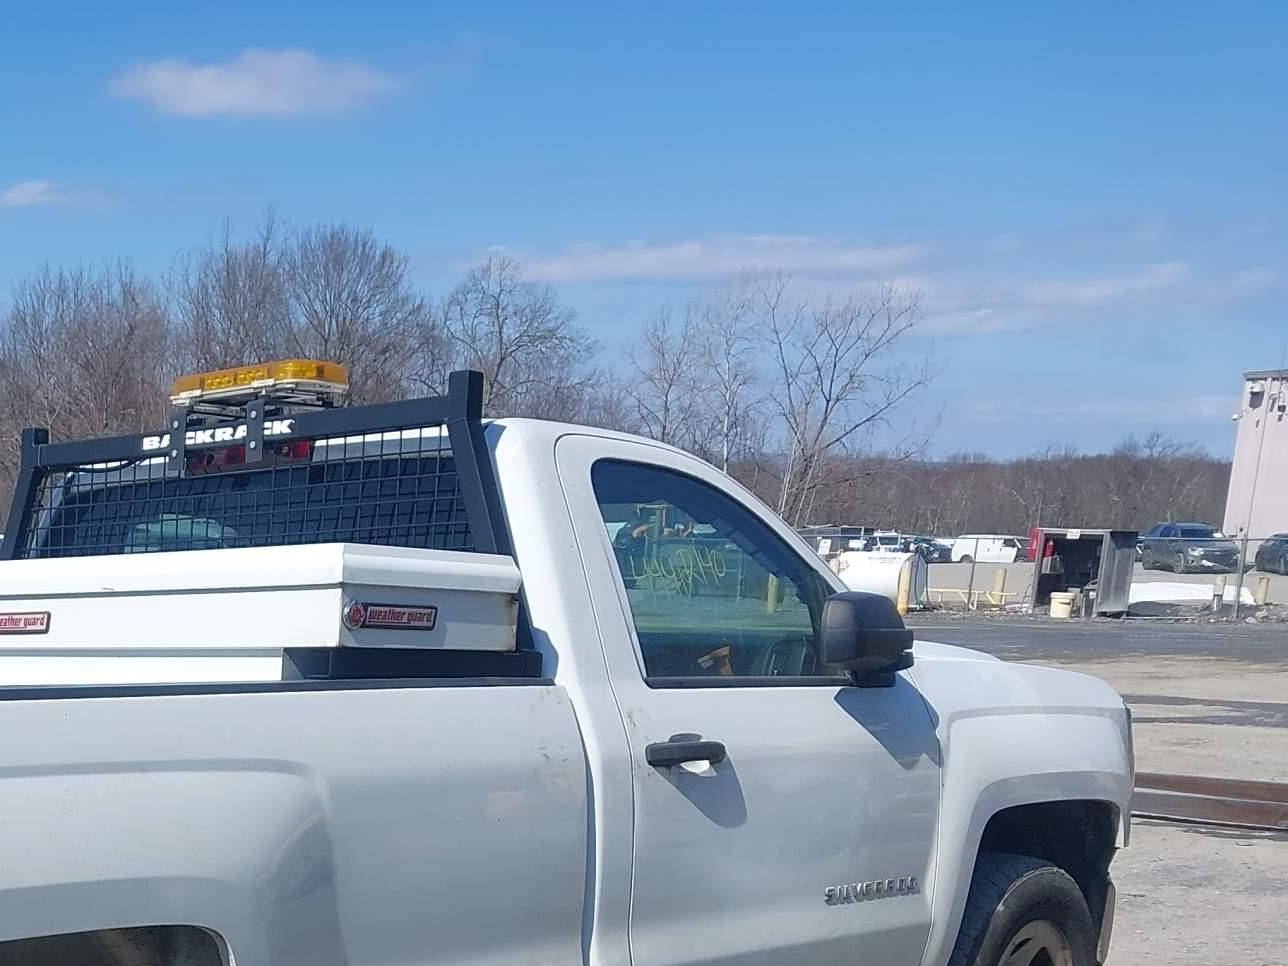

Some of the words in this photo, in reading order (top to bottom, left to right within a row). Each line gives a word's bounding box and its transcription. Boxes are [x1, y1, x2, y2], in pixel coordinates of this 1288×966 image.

[24, 613, 45, 628] guard
[368, 608, 406, 621] weather
[408, 611, 433, 625] guard
